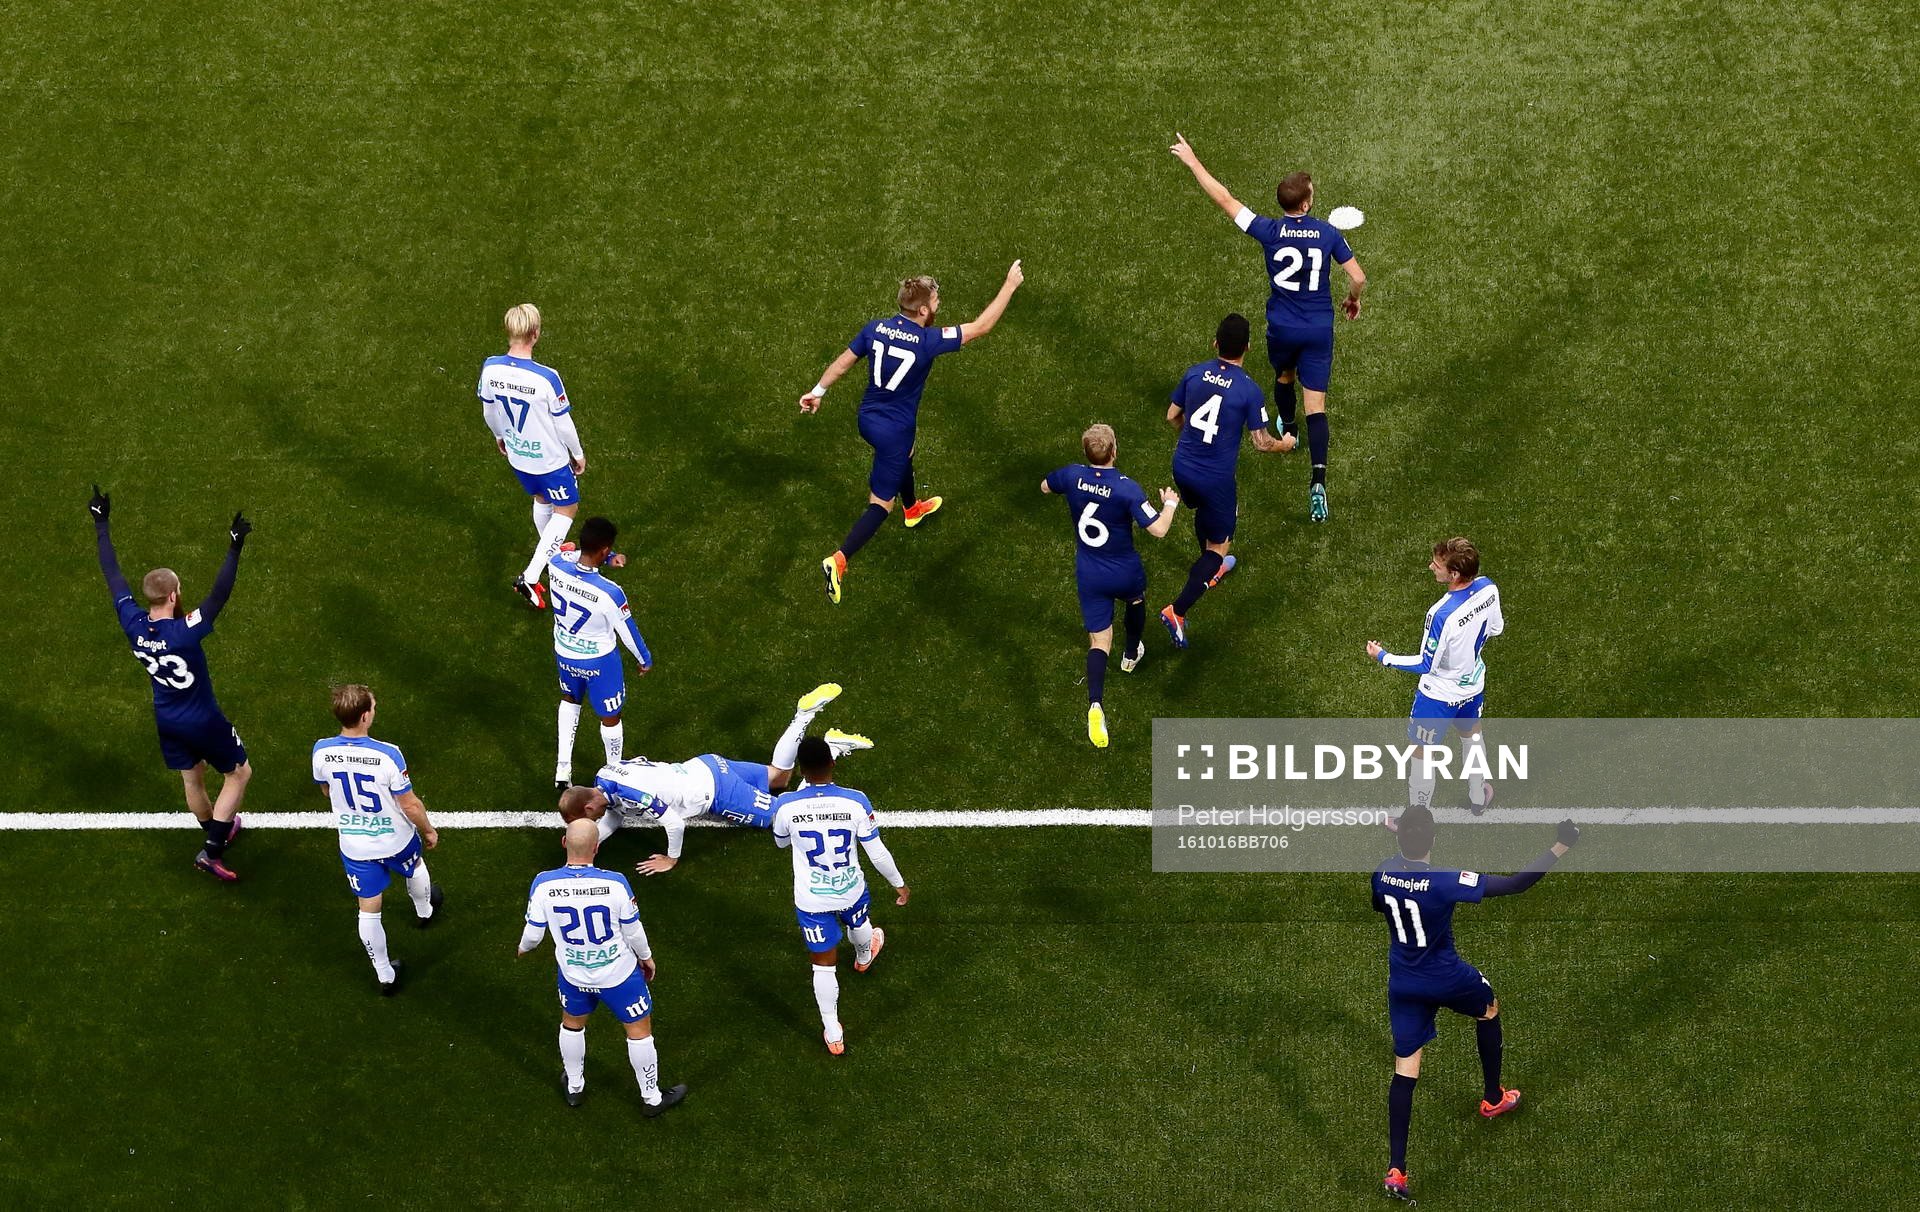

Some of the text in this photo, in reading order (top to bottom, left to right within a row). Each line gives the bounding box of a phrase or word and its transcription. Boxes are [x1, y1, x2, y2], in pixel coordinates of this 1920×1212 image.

[1280, 224, 1320, 239] Árnason
[1273, 246, 1323, 291] 21
[875, 322, 920, 344] Bengtsson
[872, 340, 916, 391] 17
[1202, 371, 1233, 389] Safari
[495, 394, 530, 434] 17
[1190, 394, 1223, 444] 4
[1077, 478, 1112, 498] Lewicki
[1078, 502, 1110, 547] 6
[551, 588, 592, 635] 27
[137, 635, 167, 653] Berget
[332, 771, 383, 813] 15
[340, 814, 393, 829] SEFAB
[792, 814, 814, 823] axs
[799, 829, 852, 871] 23
[810, 866, 857, 887] SEFAB
[549, 888, 570, 898] axs
[553, 904, 615, 945] 20
[1384, 894, 1427, 948] 11
[565, 943, 618, 961] SEFAB
